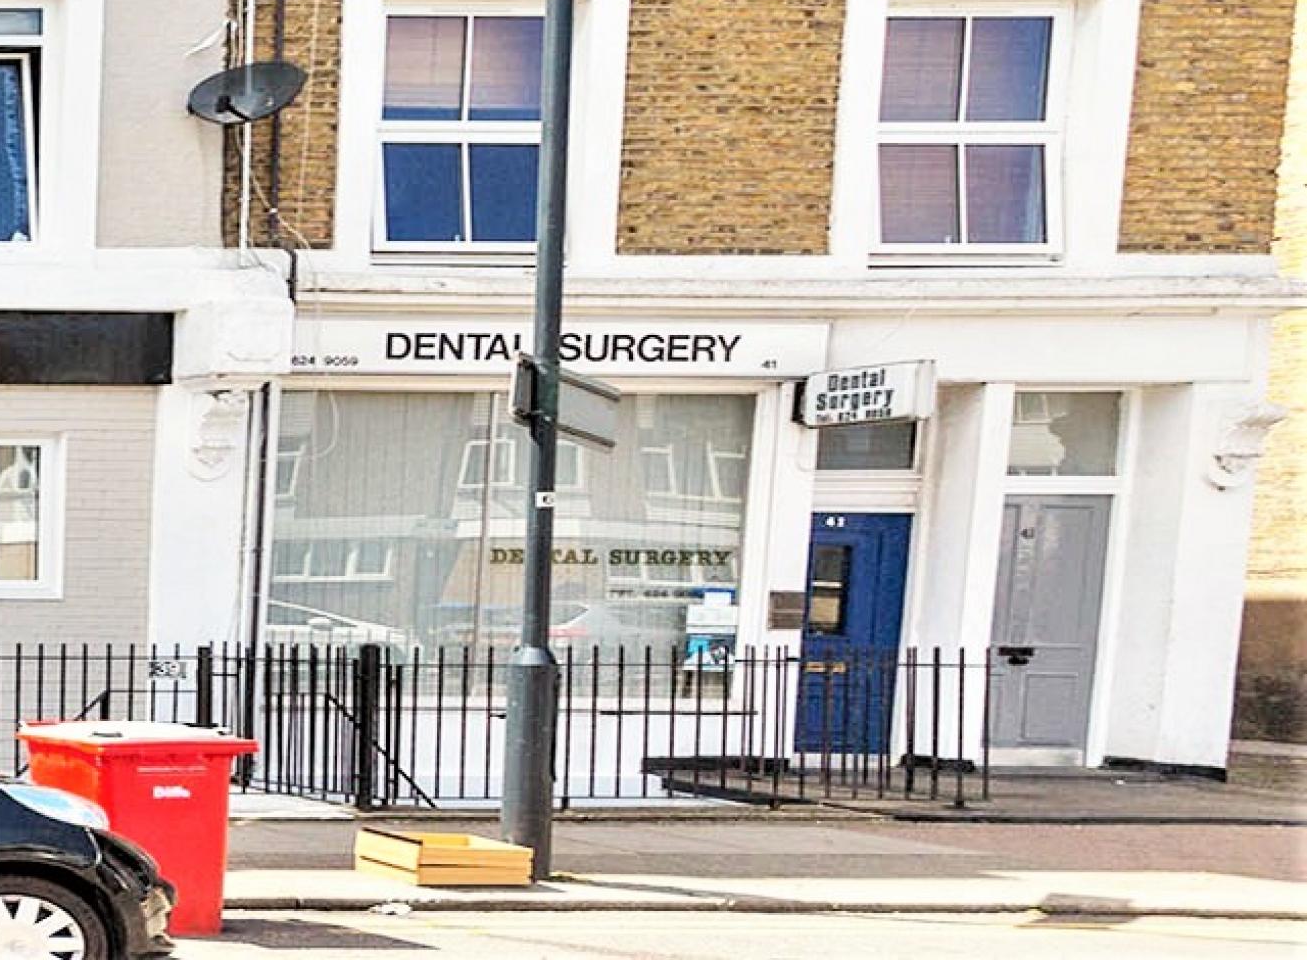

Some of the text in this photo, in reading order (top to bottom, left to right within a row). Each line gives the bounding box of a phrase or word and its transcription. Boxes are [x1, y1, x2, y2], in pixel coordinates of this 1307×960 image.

[558, 333, 742, 362] SURGERY
[827, 367, 886, 392] Dental
[816, 389, 894, 411] Surgery
[489, 548, 734, 566] DETAL SURGERY
